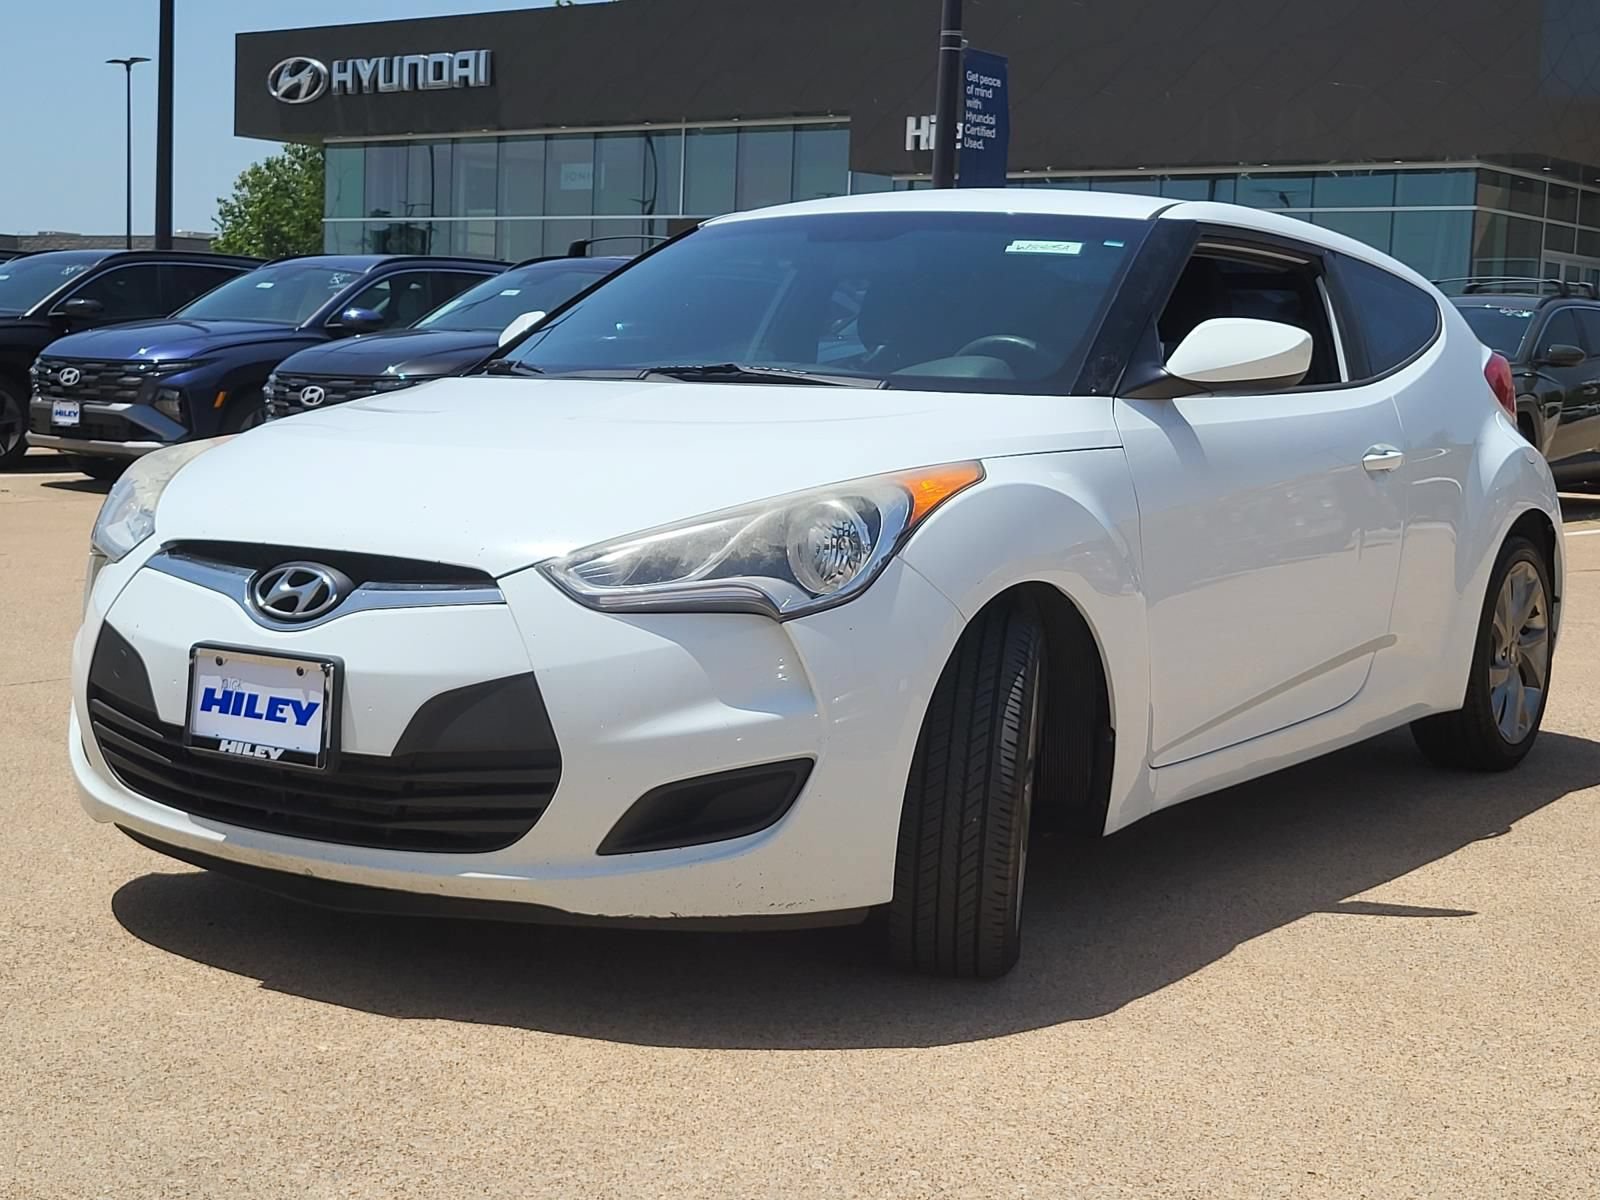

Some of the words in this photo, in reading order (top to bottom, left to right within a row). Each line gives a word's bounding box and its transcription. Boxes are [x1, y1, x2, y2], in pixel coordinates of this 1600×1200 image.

[331, 49, 492, 95] HYUNDAI
[966, 70, 979, 83] Get
[979, 75, 1001, 88] peace
[966, 84, 974, 95] of
[974, 86, 993, 98] mind
[966, 97, 982, 110] with
[965, 110, 996, 125] Hyundai
[964, 123, 996, 138] Certified
[963, 137, 984, 150] Used.
[55, 409, 78, 417] HILEY
[200, 687, 321, 726] HILEY
[218, 739, 285, 760] HILEY
